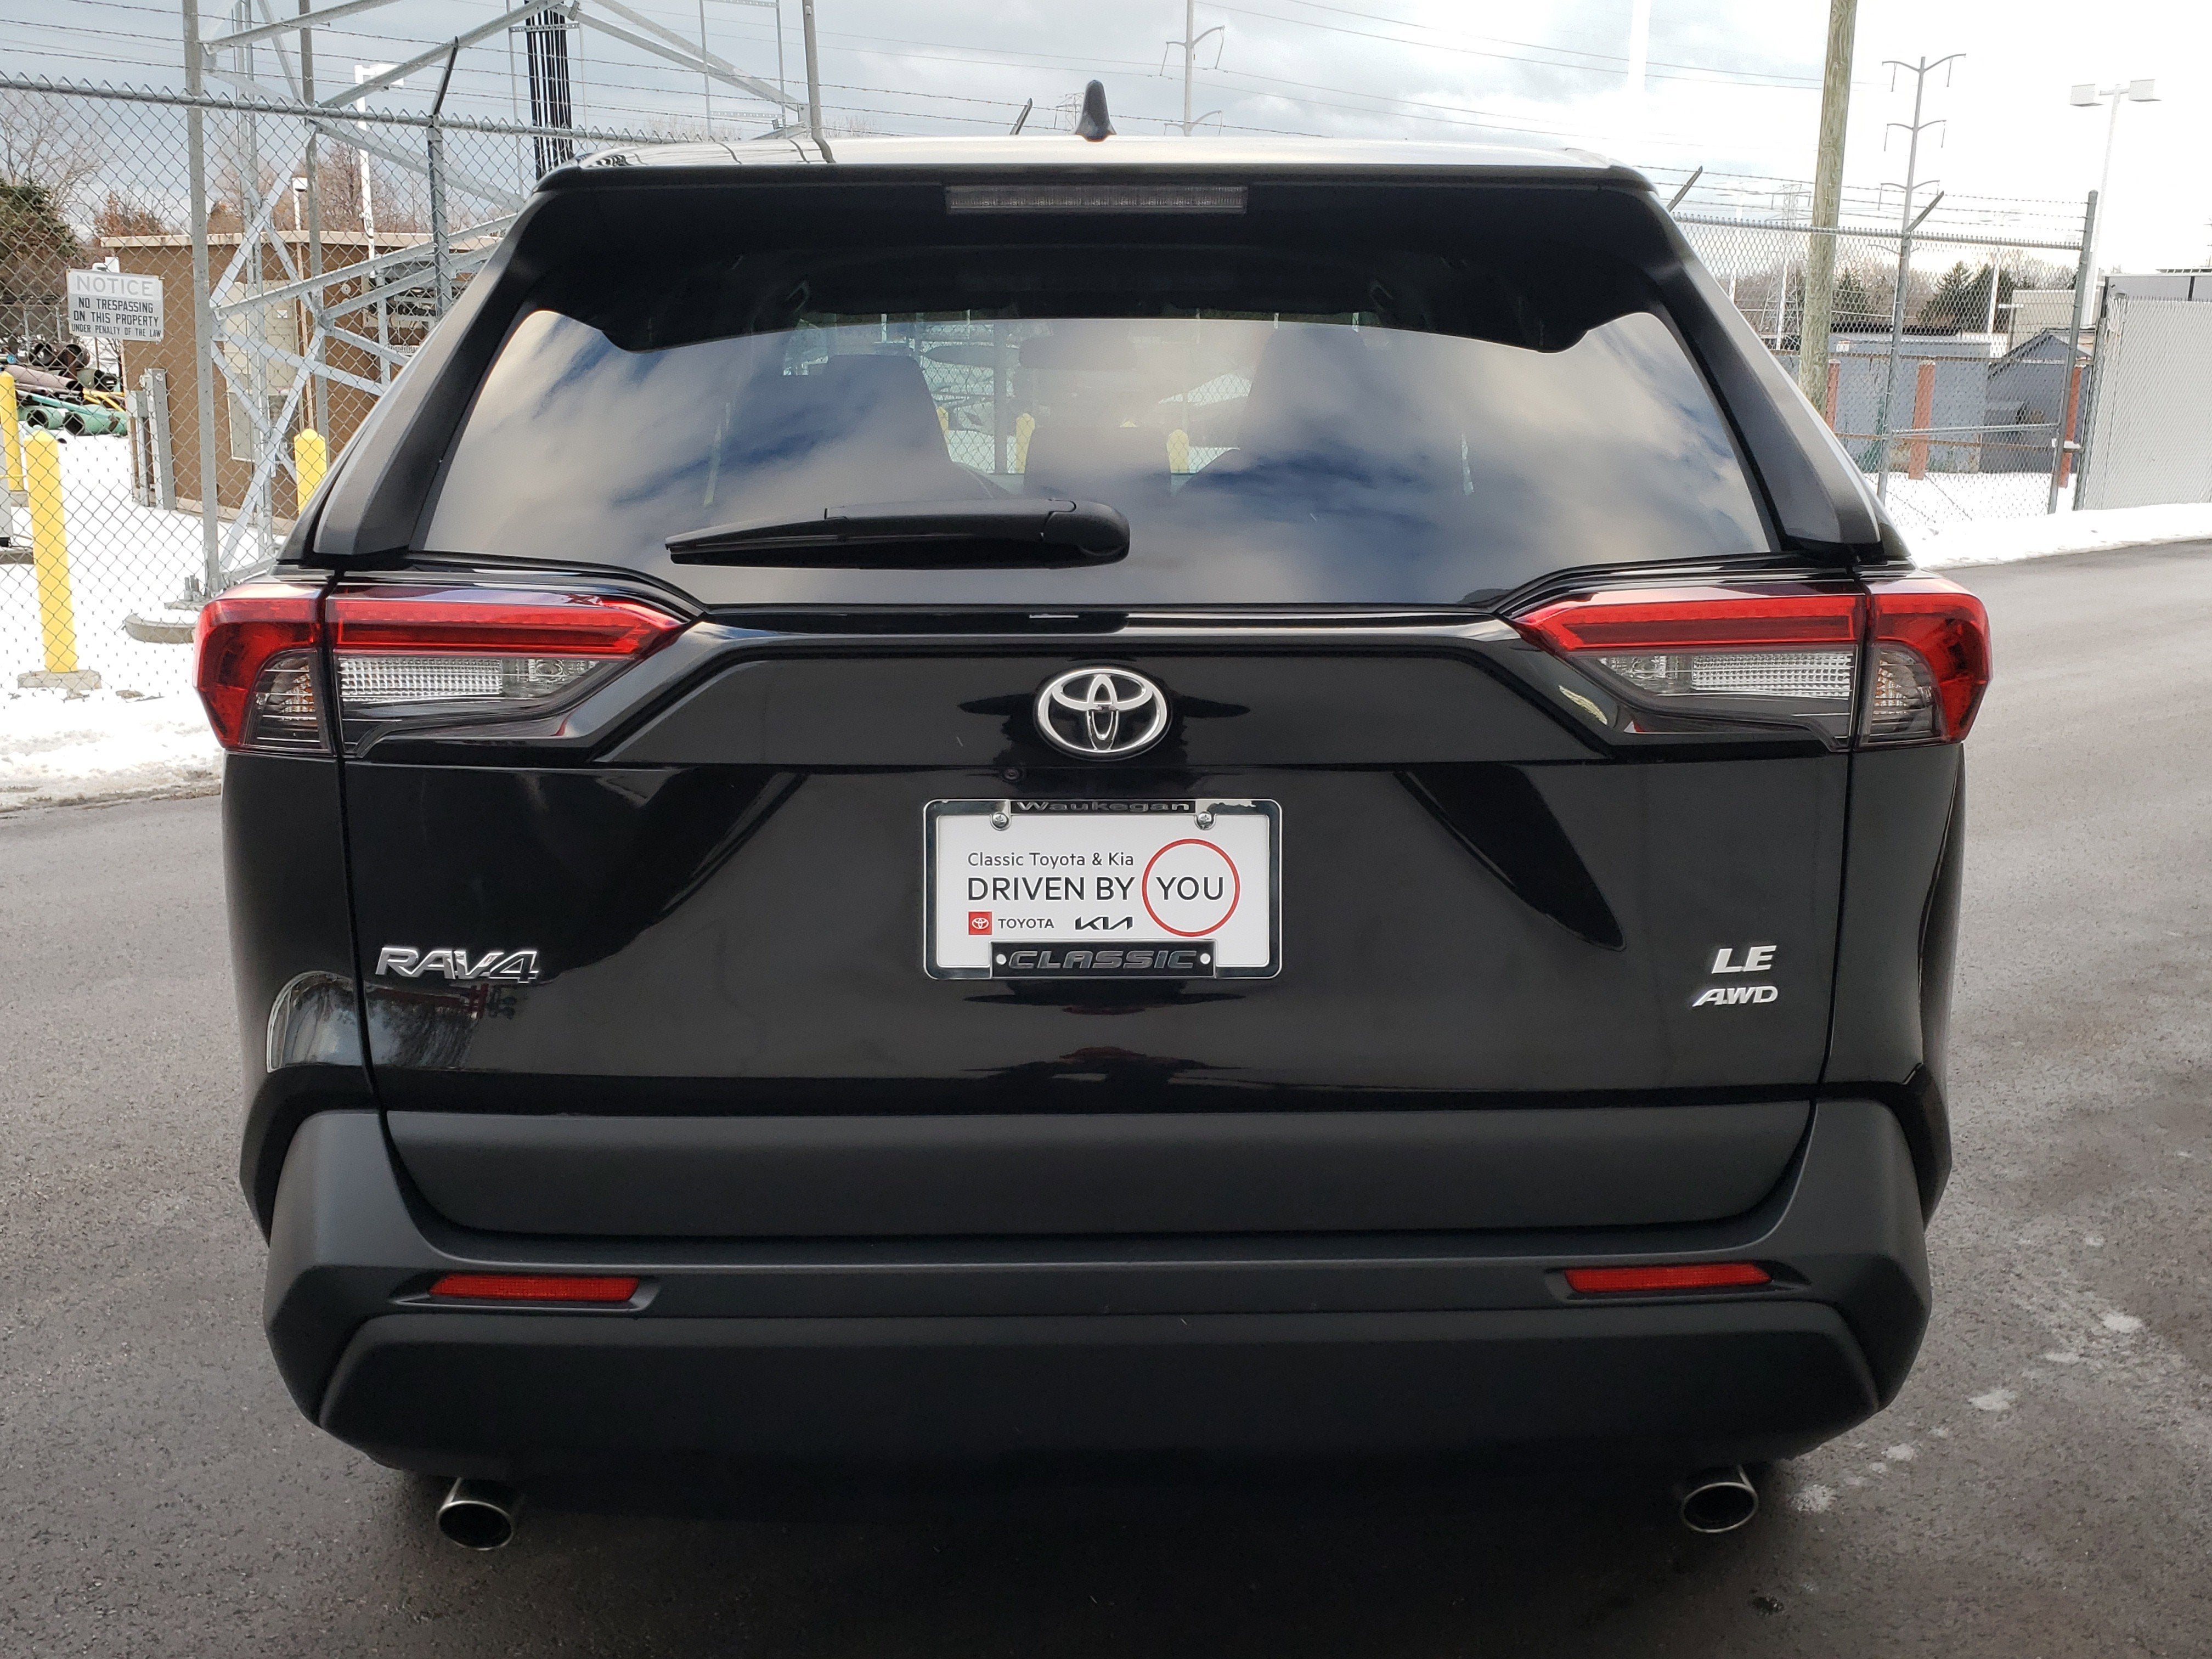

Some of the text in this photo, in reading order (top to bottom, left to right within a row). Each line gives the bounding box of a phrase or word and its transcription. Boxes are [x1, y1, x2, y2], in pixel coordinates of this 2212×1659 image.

[76, 275, 153, 297] NOTICE
[78, 297, 153, 313] NO TRESPASSING
[74, 311, 159, 327] ON THIS PROPERTY
[71, 323, 91, 332] UNDER
[95, 325, 120, 335] PENALTY
[136, 328, 146, 336] THE
[149, 329, 161, 337] LAW
[1017, 801, 1191, 812] Waukegan
[968, 852, 1134, 870] Classic Toyota & Kia
[968, 877, 1224, 901] DRIVEN BY YOU
[998, 918, 1054, 929] TOYOTA
[375, 947, 539, 983] RAV4
[1009, 950, 1197, 969] CLASSIC
[1711, 945, 1777, 974] LE
[1692, 986, 1779, 1007] AWD
